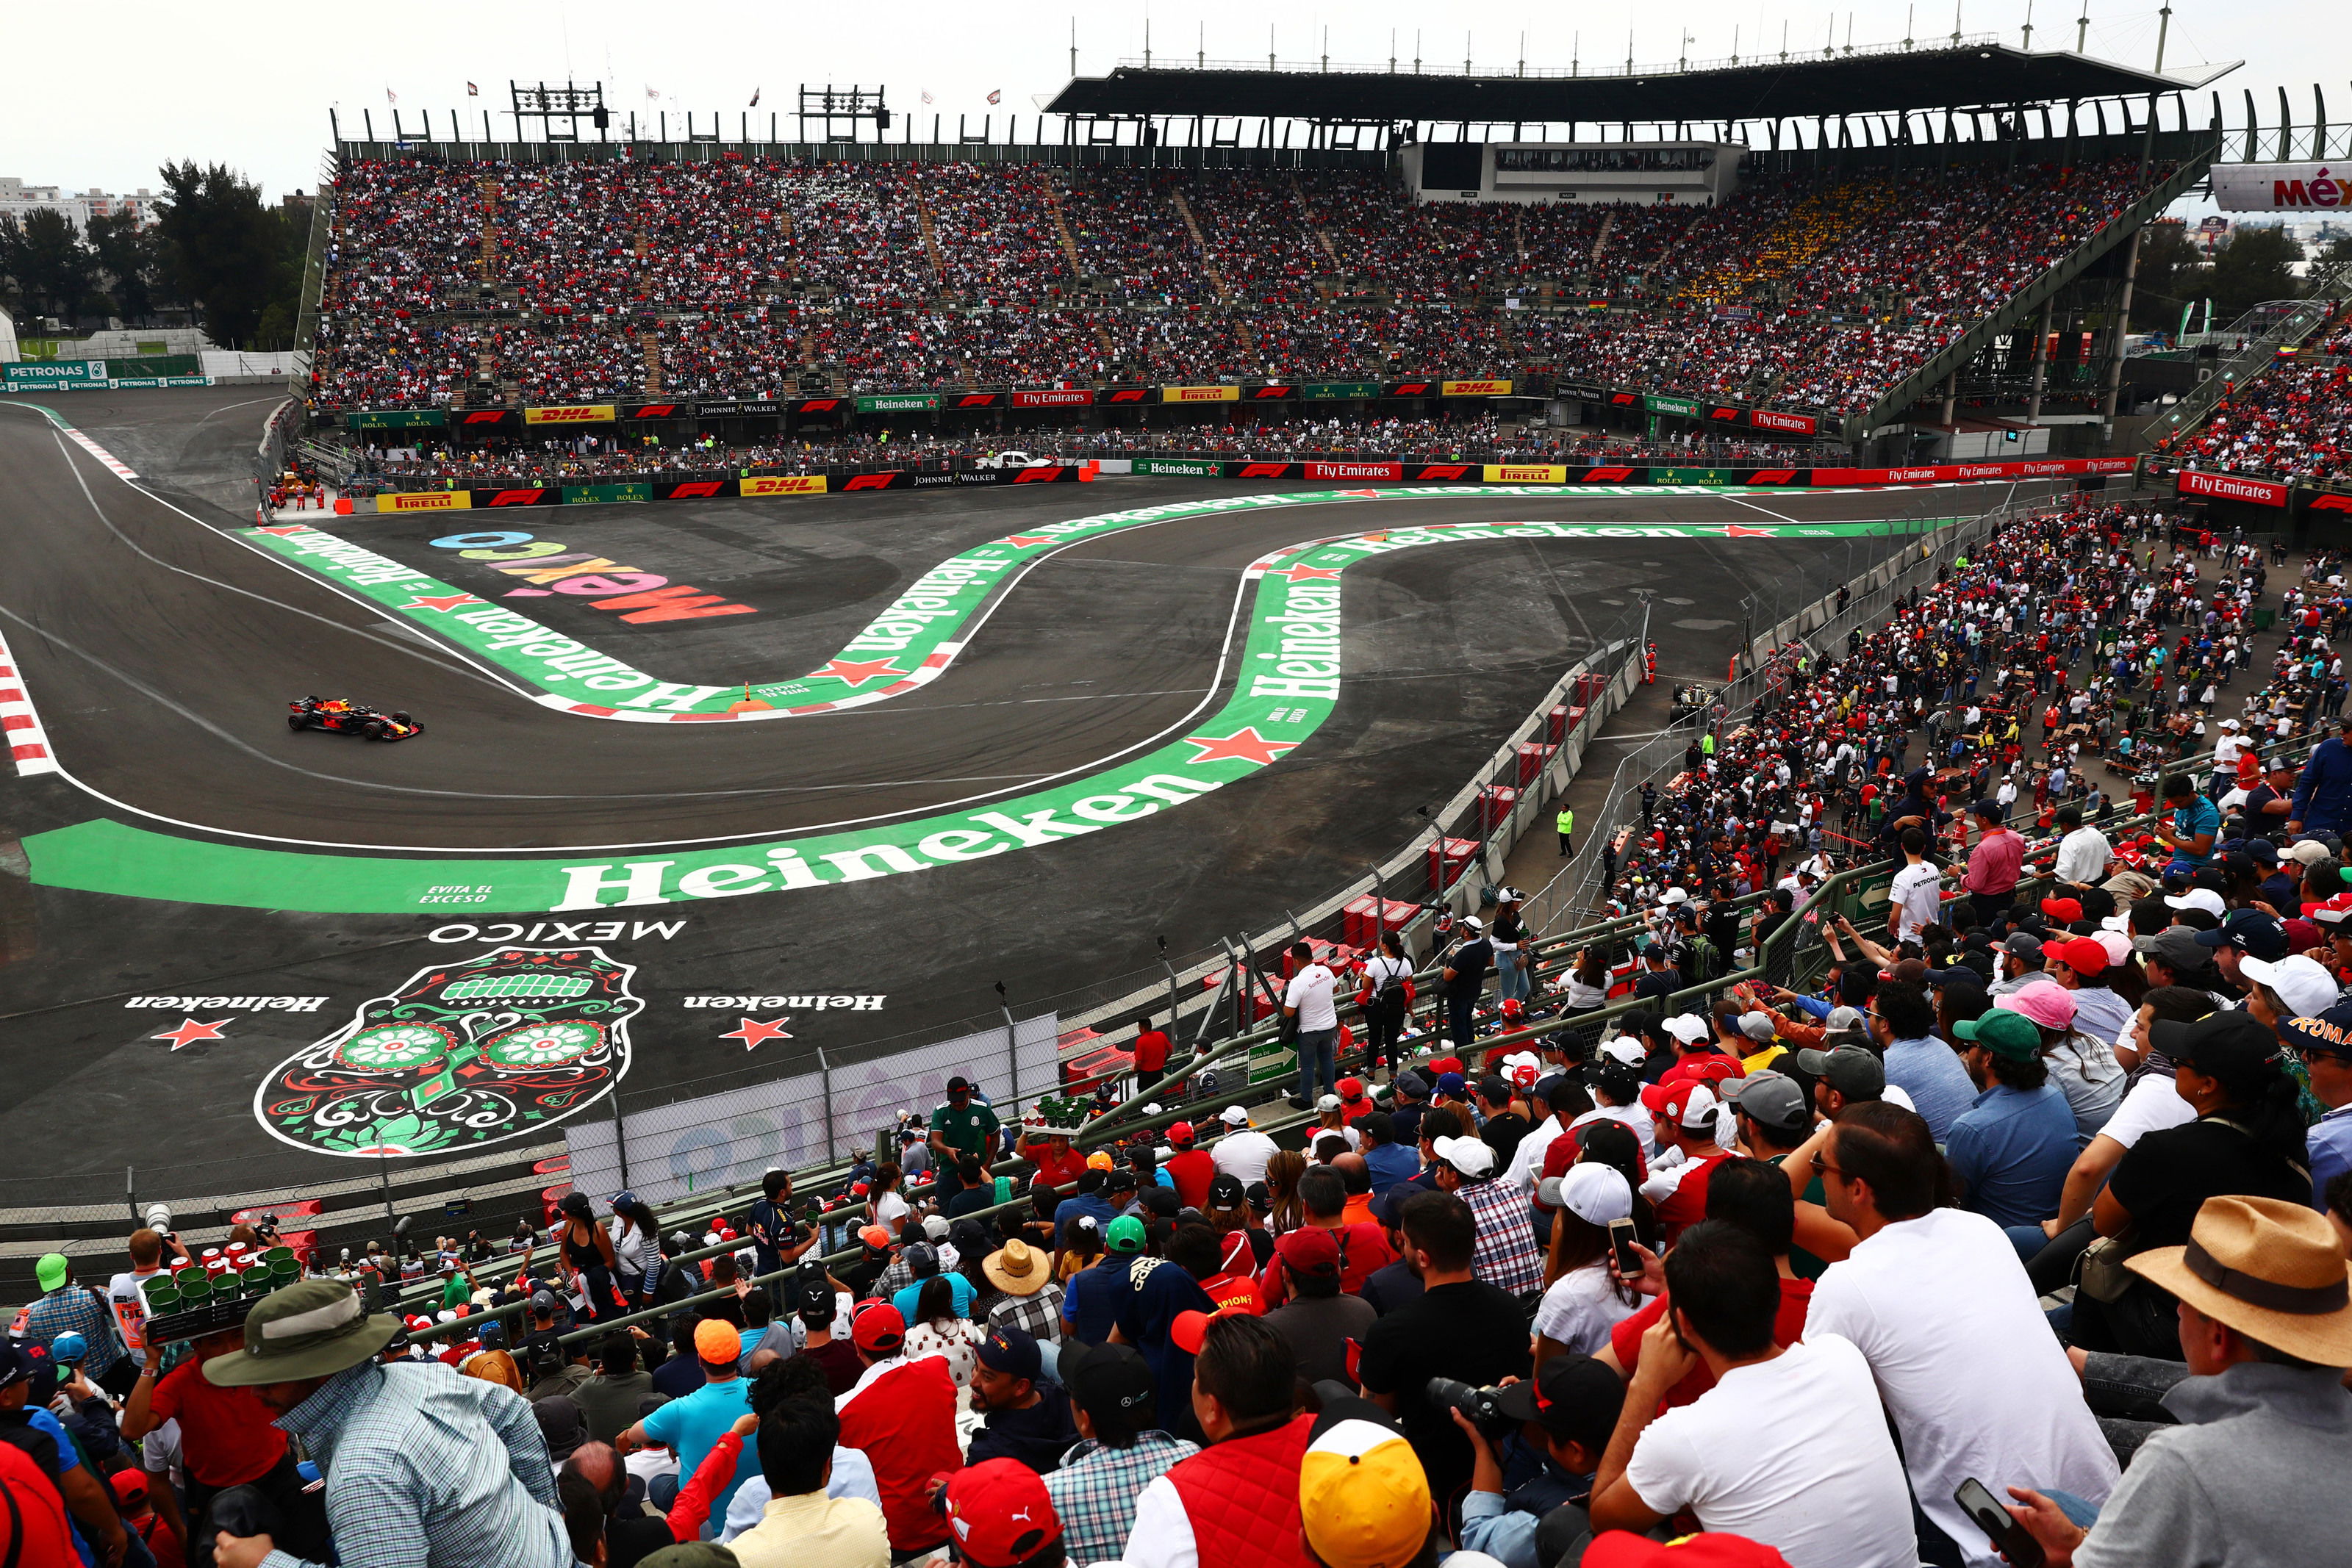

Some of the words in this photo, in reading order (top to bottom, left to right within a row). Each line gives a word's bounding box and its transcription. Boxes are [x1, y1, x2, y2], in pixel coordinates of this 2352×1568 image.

[10, 366, 84, 377] PETRONAS
[1453, 382, 1496, 393] DHL
[1557, 387, 1577, 397] JOHNNIE
[1580, 390, 1600, 400] WALKER
[1024, 394, 1041, 405] Fly
[1042, 393, 1084, 403] Emirates
[1181, 389, 1222, 400] PIRELLI
[700, 406, 736, 415] JOHNNIE
[743, 405, 777, 413] WALKER
[875, 399, 923, 409] Heineken
[1656, 400, 1688, 414] Heineken
[540, 408, 592, 421] DHL
[1758, 413, 1771, 427] Fly
[1772, 415, 1806, 430] Emirates
[1150, 463, 1203, 475] Heineken
[1316, 464, 1336, 478] Fly
[1338, 464, 1390, 477] Emirates
[1959, 467, 1971, 477] Fly
[1972, 465, 2002, 476] Emirates
[2023, 464, 2036, 474] Fly
[2037, 462, 2065, 473] Emirates
[2098, 460, 2126, 470] Emirates
[914, 475, 953, 486] JOHNNIE
[960, 473, 997, 482] WALKER
[1500, 468, 1549, 480] PIRELLI
[1888, 470, 1902, 481] Fly
[1903, 469, 1935, 480] Emirates
[755, 478, 814, 493] DHL
[1399, 486, 1723, 496] Heineken
[2190, 475, 2213, 493] Fly
[2215, 480, 2272, 500] Emirates
[395, 494, 451, 508] PIRELLI
[1029, 495, 1300, 537] Heineken
[1328, 525, 1692, 553] Heineken
[282, 532, 431, 586] Heineken
[843, 558, 1013, 652] Heineken
[1250, 586, 1341, 700] Heineken
[453, 608, 733, 711] Heineken
[757, 683, 803, 694] EXCESO
[778, 687, 811, 696] EVITA
[550, 771, 1224, 913] Heineken
[1872, 880, 1885, 888] RUTA
[1913, 874, 1940, 888] PETRONA
[428, 885, 470, 894] EVITA
[475, 885, 493, 893] EL
[419, 894, 487, 904] EXCESO
[427, 921, 687, 943] MEXICO
[1308, 974, 1331, 989] Santander
[124, 996, 330, 1013] Heineken
[683, 995, 887, 1012] Heineken
[2287, 1017, 2352, 1046] ROMA
